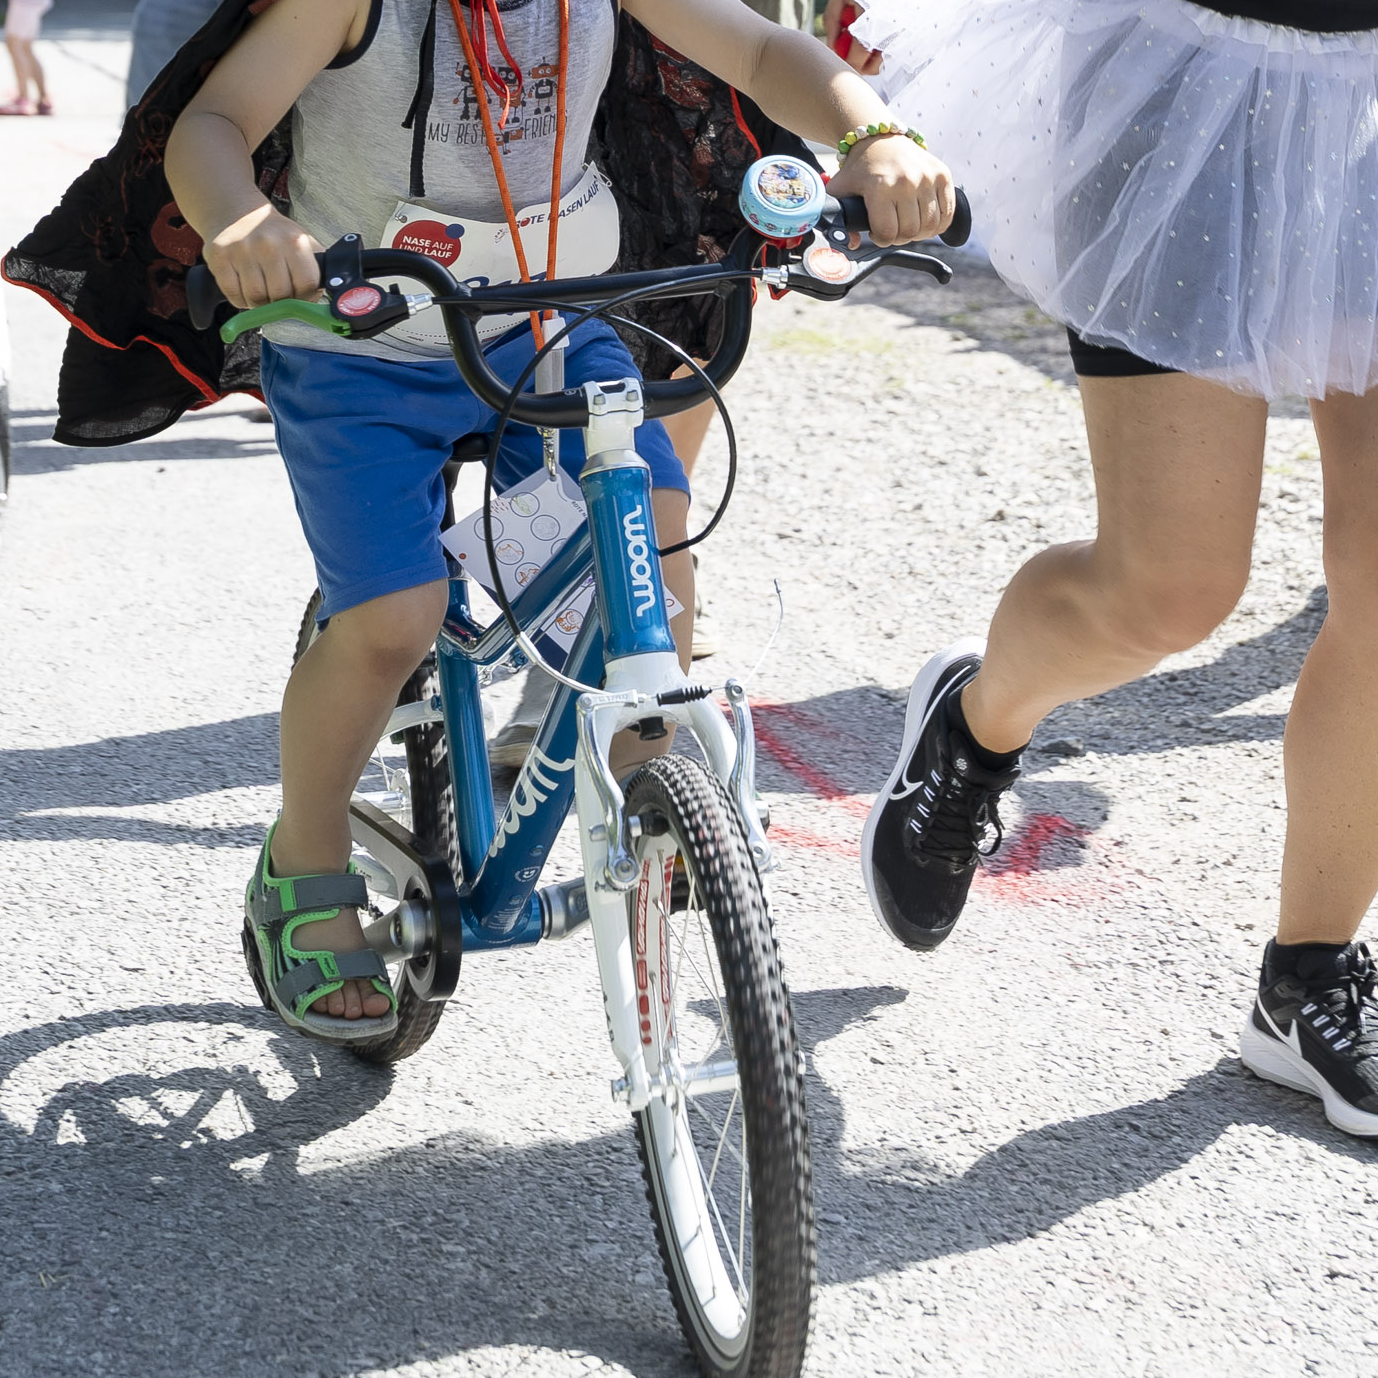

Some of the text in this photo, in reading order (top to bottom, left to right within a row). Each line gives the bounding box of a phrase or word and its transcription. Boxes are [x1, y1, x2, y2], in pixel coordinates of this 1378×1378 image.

[427, 122, 450, 144] MY
[547, 199, 583, 222] ASEN
[583, 180, 600, 205] LAUF
[402, 234, 454, 252] NASE AUF
[423, 247, 453, 260] LAUF
[623, 504, 656, 618] woom
